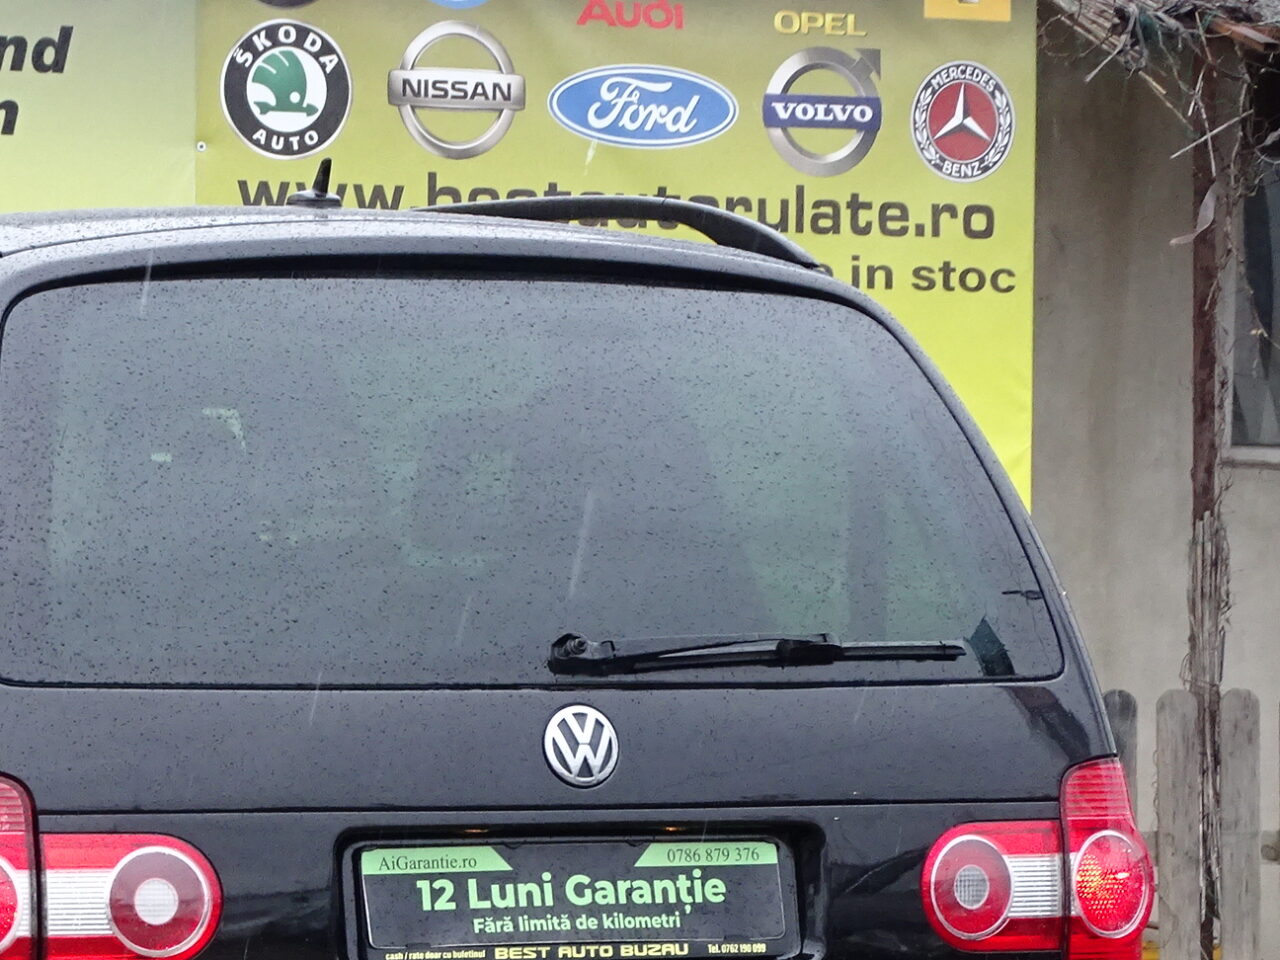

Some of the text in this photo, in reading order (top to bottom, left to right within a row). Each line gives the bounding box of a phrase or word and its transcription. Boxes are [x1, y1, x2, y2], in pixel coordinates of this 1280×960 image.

[774, 10, 867, 37] OPEL
[401, 78, 512, 102] NISSAN
[930, 65, 997, 92] MERCEDES
[587, 77, 701, 133] Ford
[771, 102, 873, 124] VOLVO
[252, 128, 319, 151] AUTO
[942, 160, 982, 177] BENZ
[911, 261, 1016, 293] stoc
[379, 854, 477, 871] AiGarantie.ro
[667, 847, 760, 863] 0786 879 376
[416, 879, 457, 912] 12
[468, 871, 554, 909] Luni
[473, 911, 681, 934] Fără limită de kilometri
[385, 953, 403, 960] cash
[494, 943, 689, 960] BEST AUTO BUZAU
